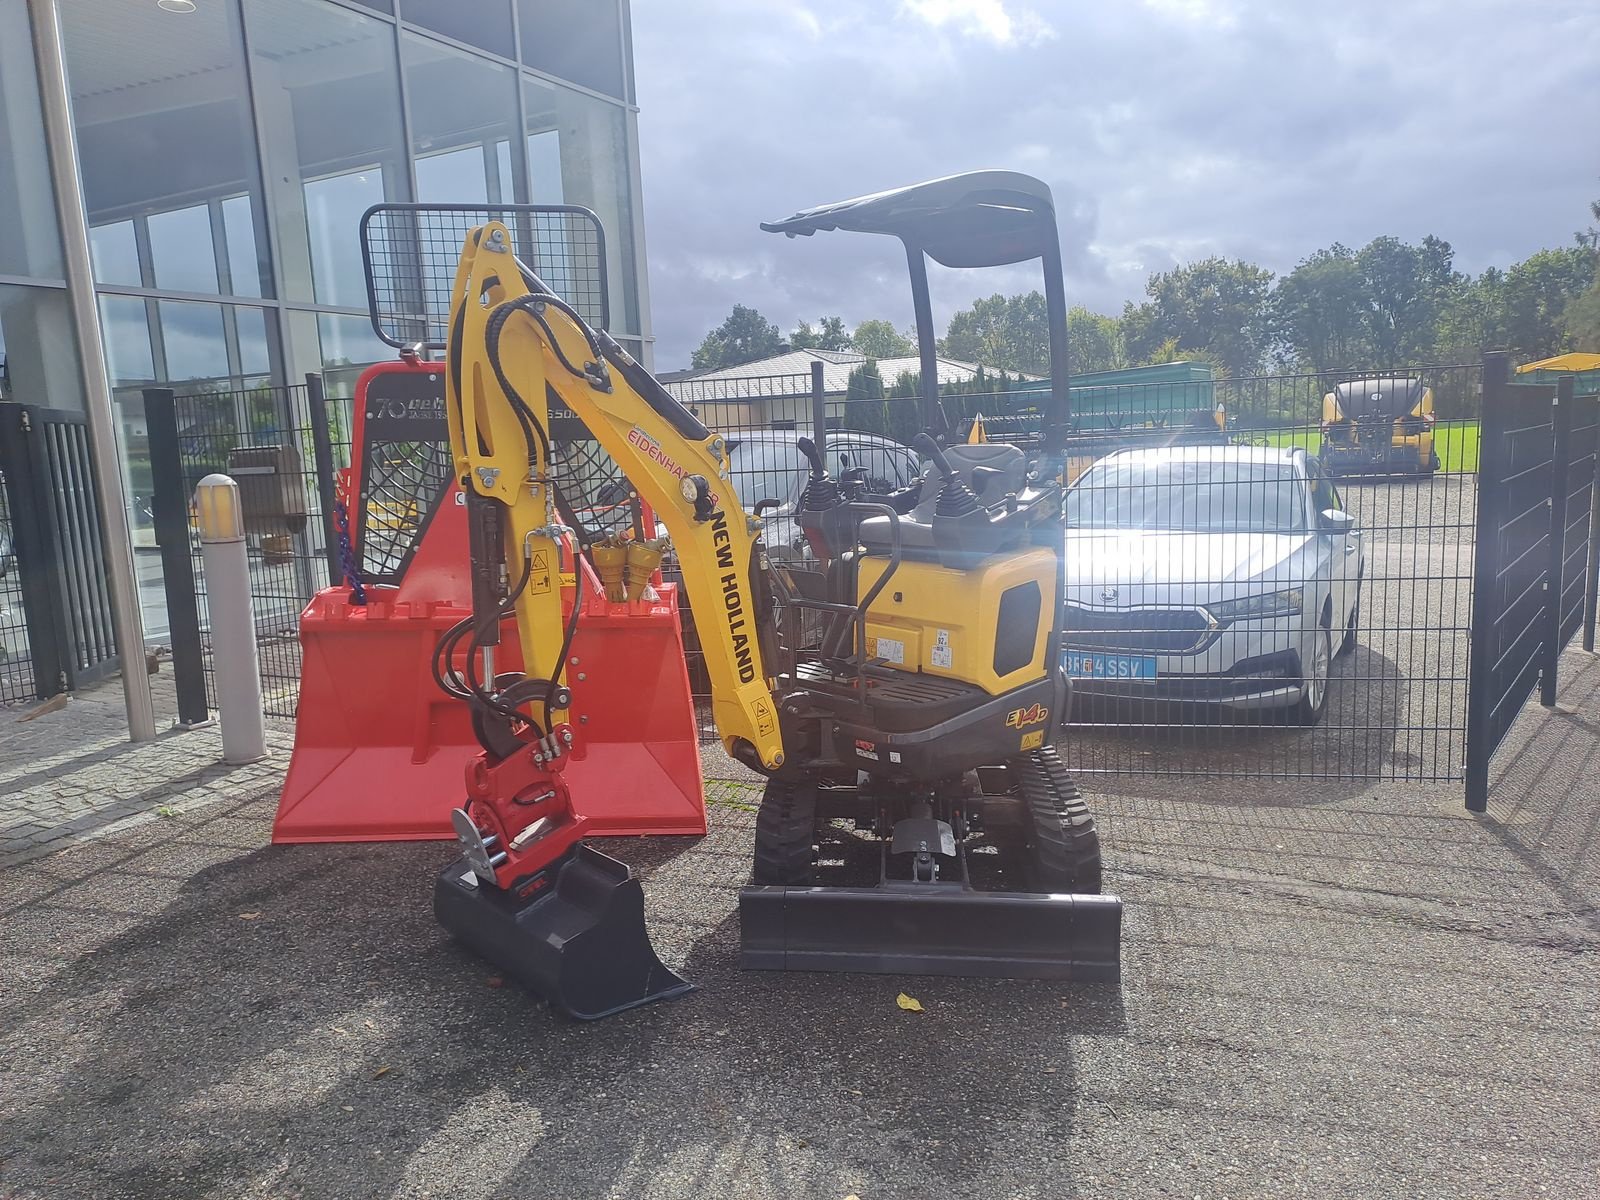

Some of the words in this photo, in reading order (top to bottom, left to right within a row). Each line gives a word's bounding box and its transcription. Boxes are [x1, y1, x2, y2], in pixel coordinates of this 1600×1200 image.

[710, 510, 734, 568] NEW
[721, 572, 755, 684] HOLLAND
[1006, 703, 1048, 729] E14D
